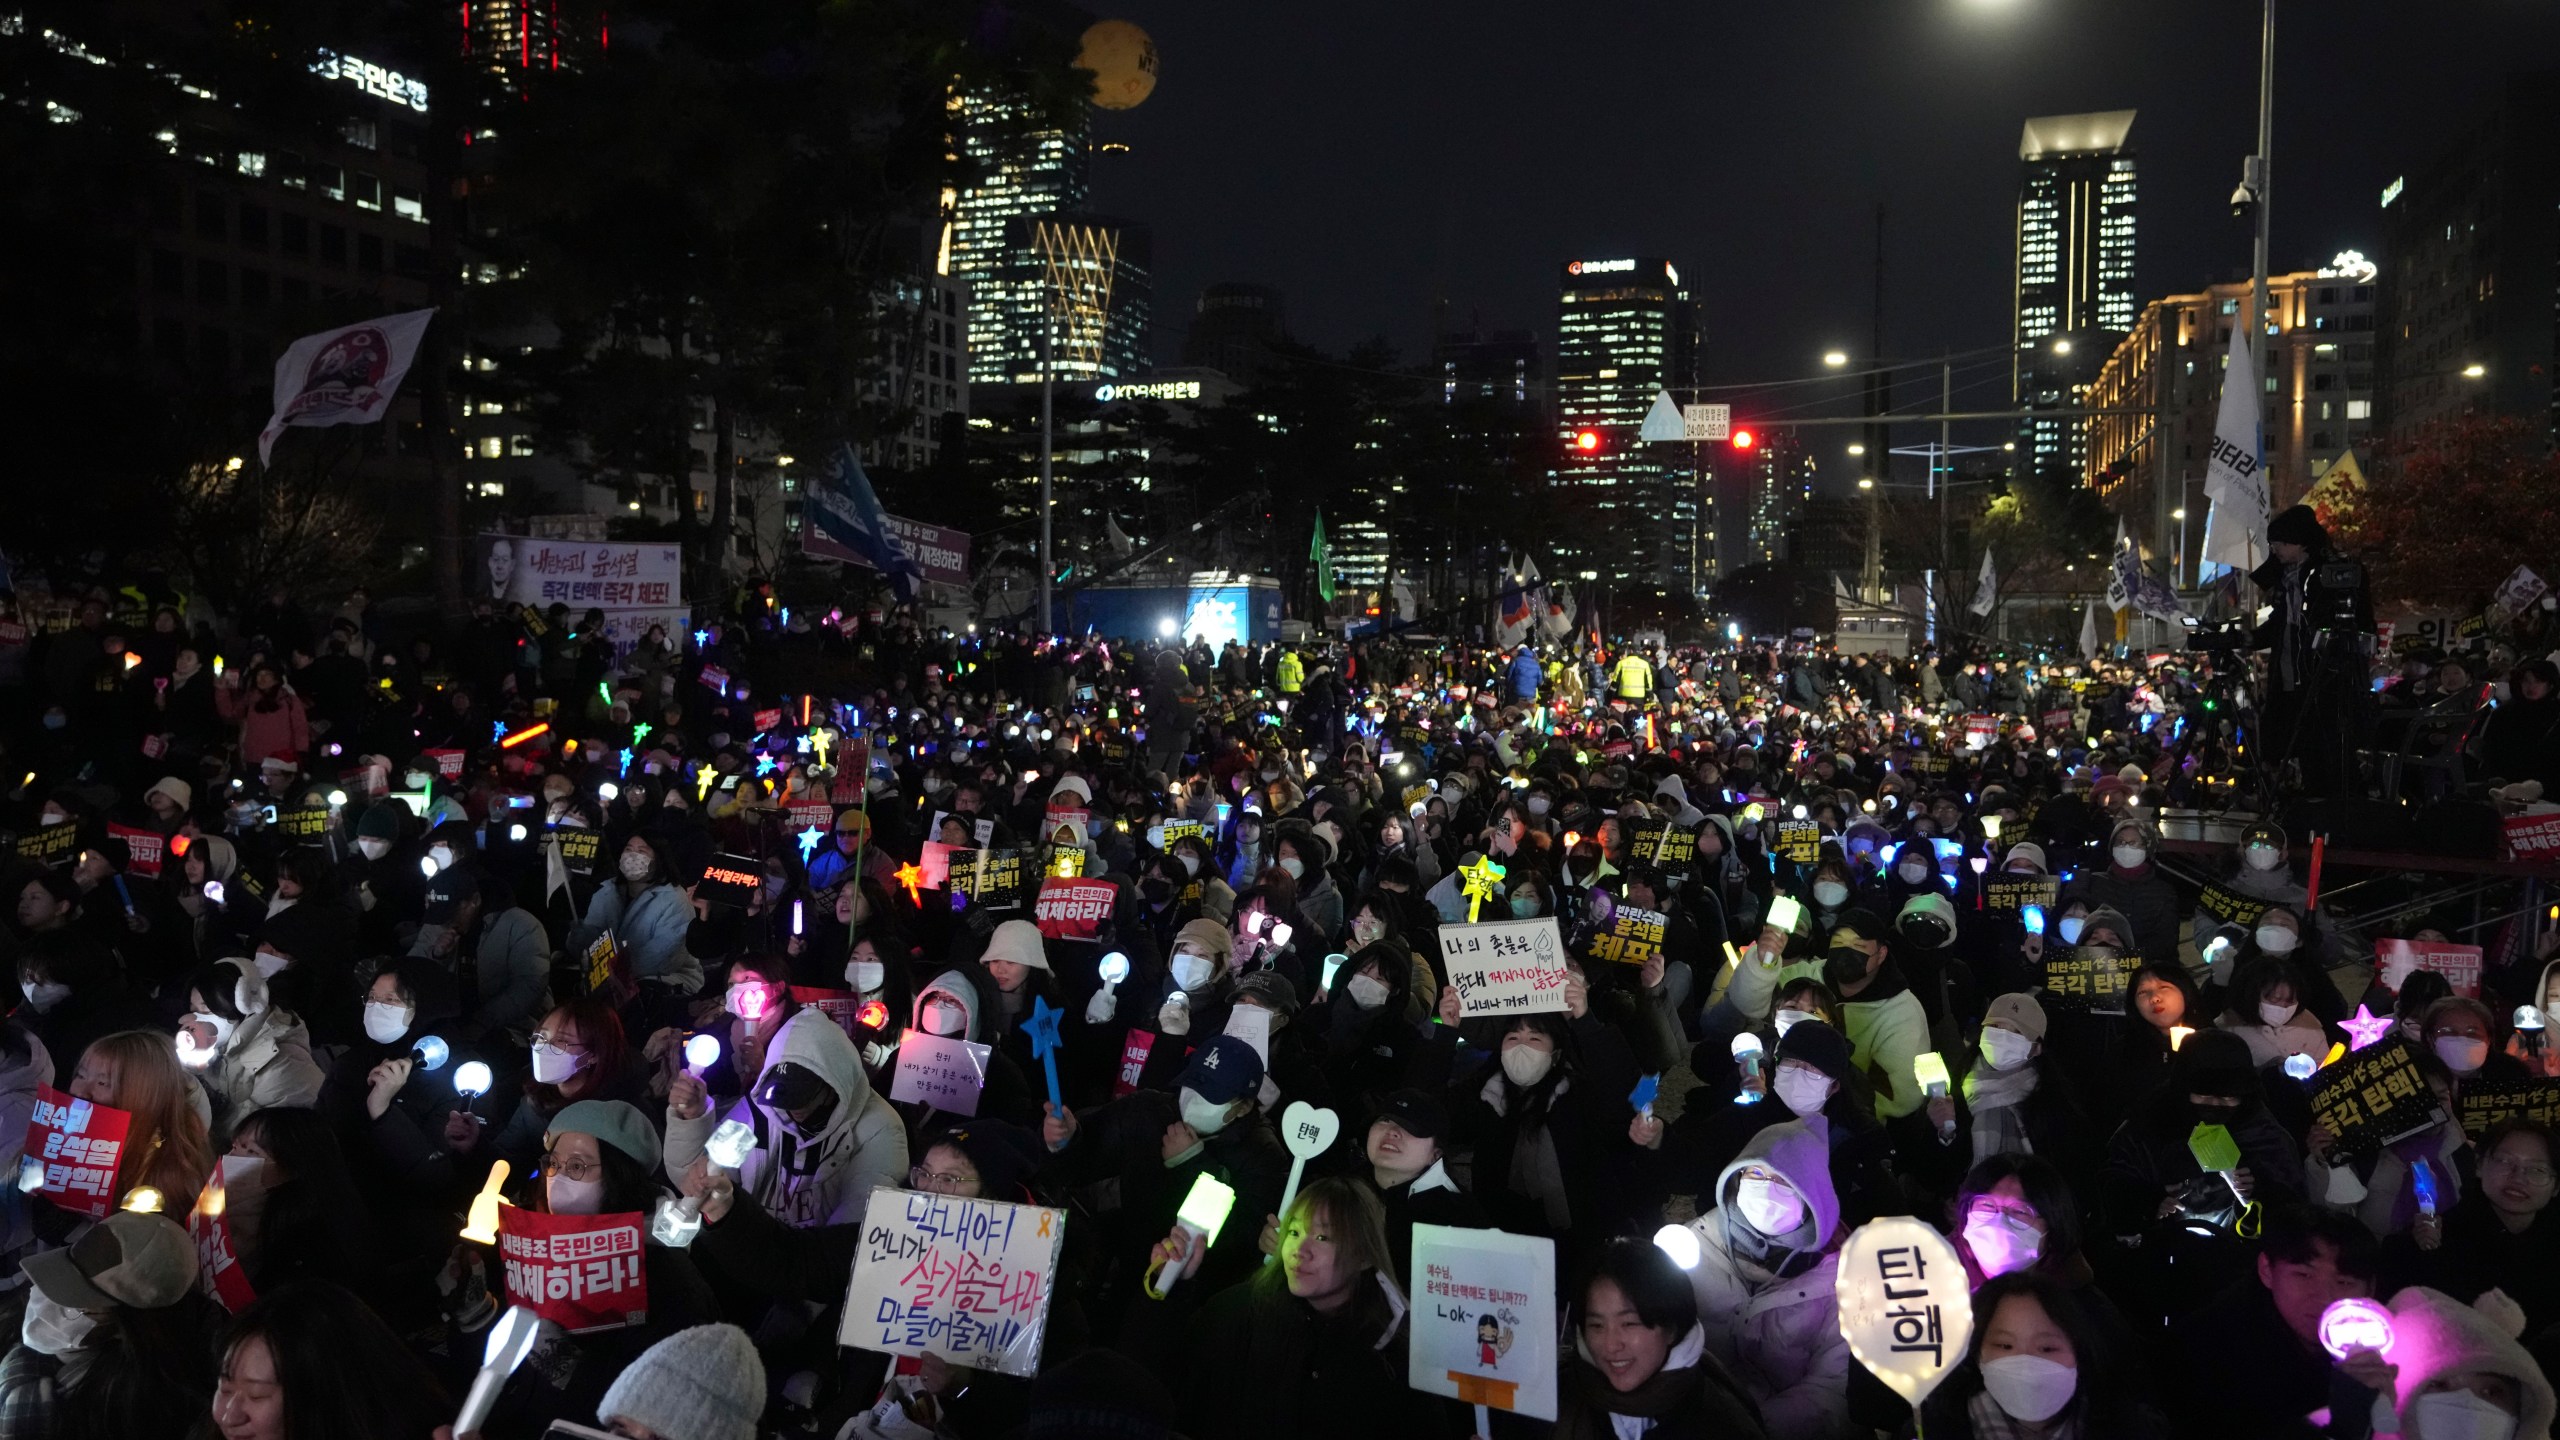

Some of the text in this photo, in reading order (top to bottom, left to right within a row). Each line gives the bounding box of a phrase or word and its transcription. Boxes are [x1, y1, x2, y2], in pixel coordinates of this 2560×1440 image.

[1686, 423, 1726, 437] 24:00-05:00
[591, 549, 638, 579] 윤석열
[542, 580, 670, 605] 즉각 탄핵! 즉각 체포!
[1779, 821, 1818, 832] 반란수괴
[1781, 829, 1820, 843] 윤석열
[46, 833, 75, 854] 탄핵!
[1671, 834, 1695, 844] 윤석열
[562, 844, 597, 859] 탄핵!
[1631, 842, 1694, 861] 즉각 탄핵!
[1774, 843, 1820, 862] 포!
[950, 861, 980, 876] 내란수괴
[990, 857, 1020, 869] 윤석열
[950, 870, 1020, 896] 즉각 탄핵!
[1073, 886, 1112, 901] 국민의힘
[1467, 868, 1496, 898] 탄핵
[1988, 881, 2056, 893] 내란수괴 윤석열
[1035, 900, 1110, 921] 해체하라!
[1989, 894, 2016, 909] 즉각
[2200, 892, 2233, 919] 즉각
[1614, 904, 1666, 927] 반란수괴
[1614, 919, 1665, 944] 윤석열
[1588, 933, 1662, 966] 체포!
[2428, 952, 2480, 968] 국민의힘
[2047, 957, 2142, 974] 내란수괴 윤석열
[1453, 969, 1487, 1000] 절대
[1488, 967, 1527, 985] 꺼지지
[2047, 973, 2088, 996] 즉각
[1466, 997, 1501, 1013] 니네나
[776, 1063, 788, 1075] NY
[1203, 1047, 1220, 1070] LA
[904, 1062, 921, 1072] 내가
[923, 1066, 939, 1078] 살기
[942, 1069, 957, 1081] 좋은
[2309, 1044, 2411, 1113] 내란수괴 윤석열
[2316, 1064, 2425, 1138] 즉각 탄핵!
[2464, 1093, 2526, 1109] 내란수괴
[1297, 1121, 1321, 1145] 탄핵
[43, 1132, 121, 1167] 윤석열
[41, 1163, 114, 1197] 탄핵!
[907, 1198, 1021, 1262] 막내야!
[502, 1229, 635, 1259] 내란동조 국민의힘
[868, 1226, 928, 1264] 언니가
[504, 1254, 641, 1306] 해체하라!
[1426, 1263, 1453, 1282] 예수님,
[1426, 1279, 1528, 1307] 윤석열 탄핵해도 됩니까???
[1876, 1244, 1945, 1369] 탄핵
[876, 1296, 1021, 1354] 만들어줄게!!
